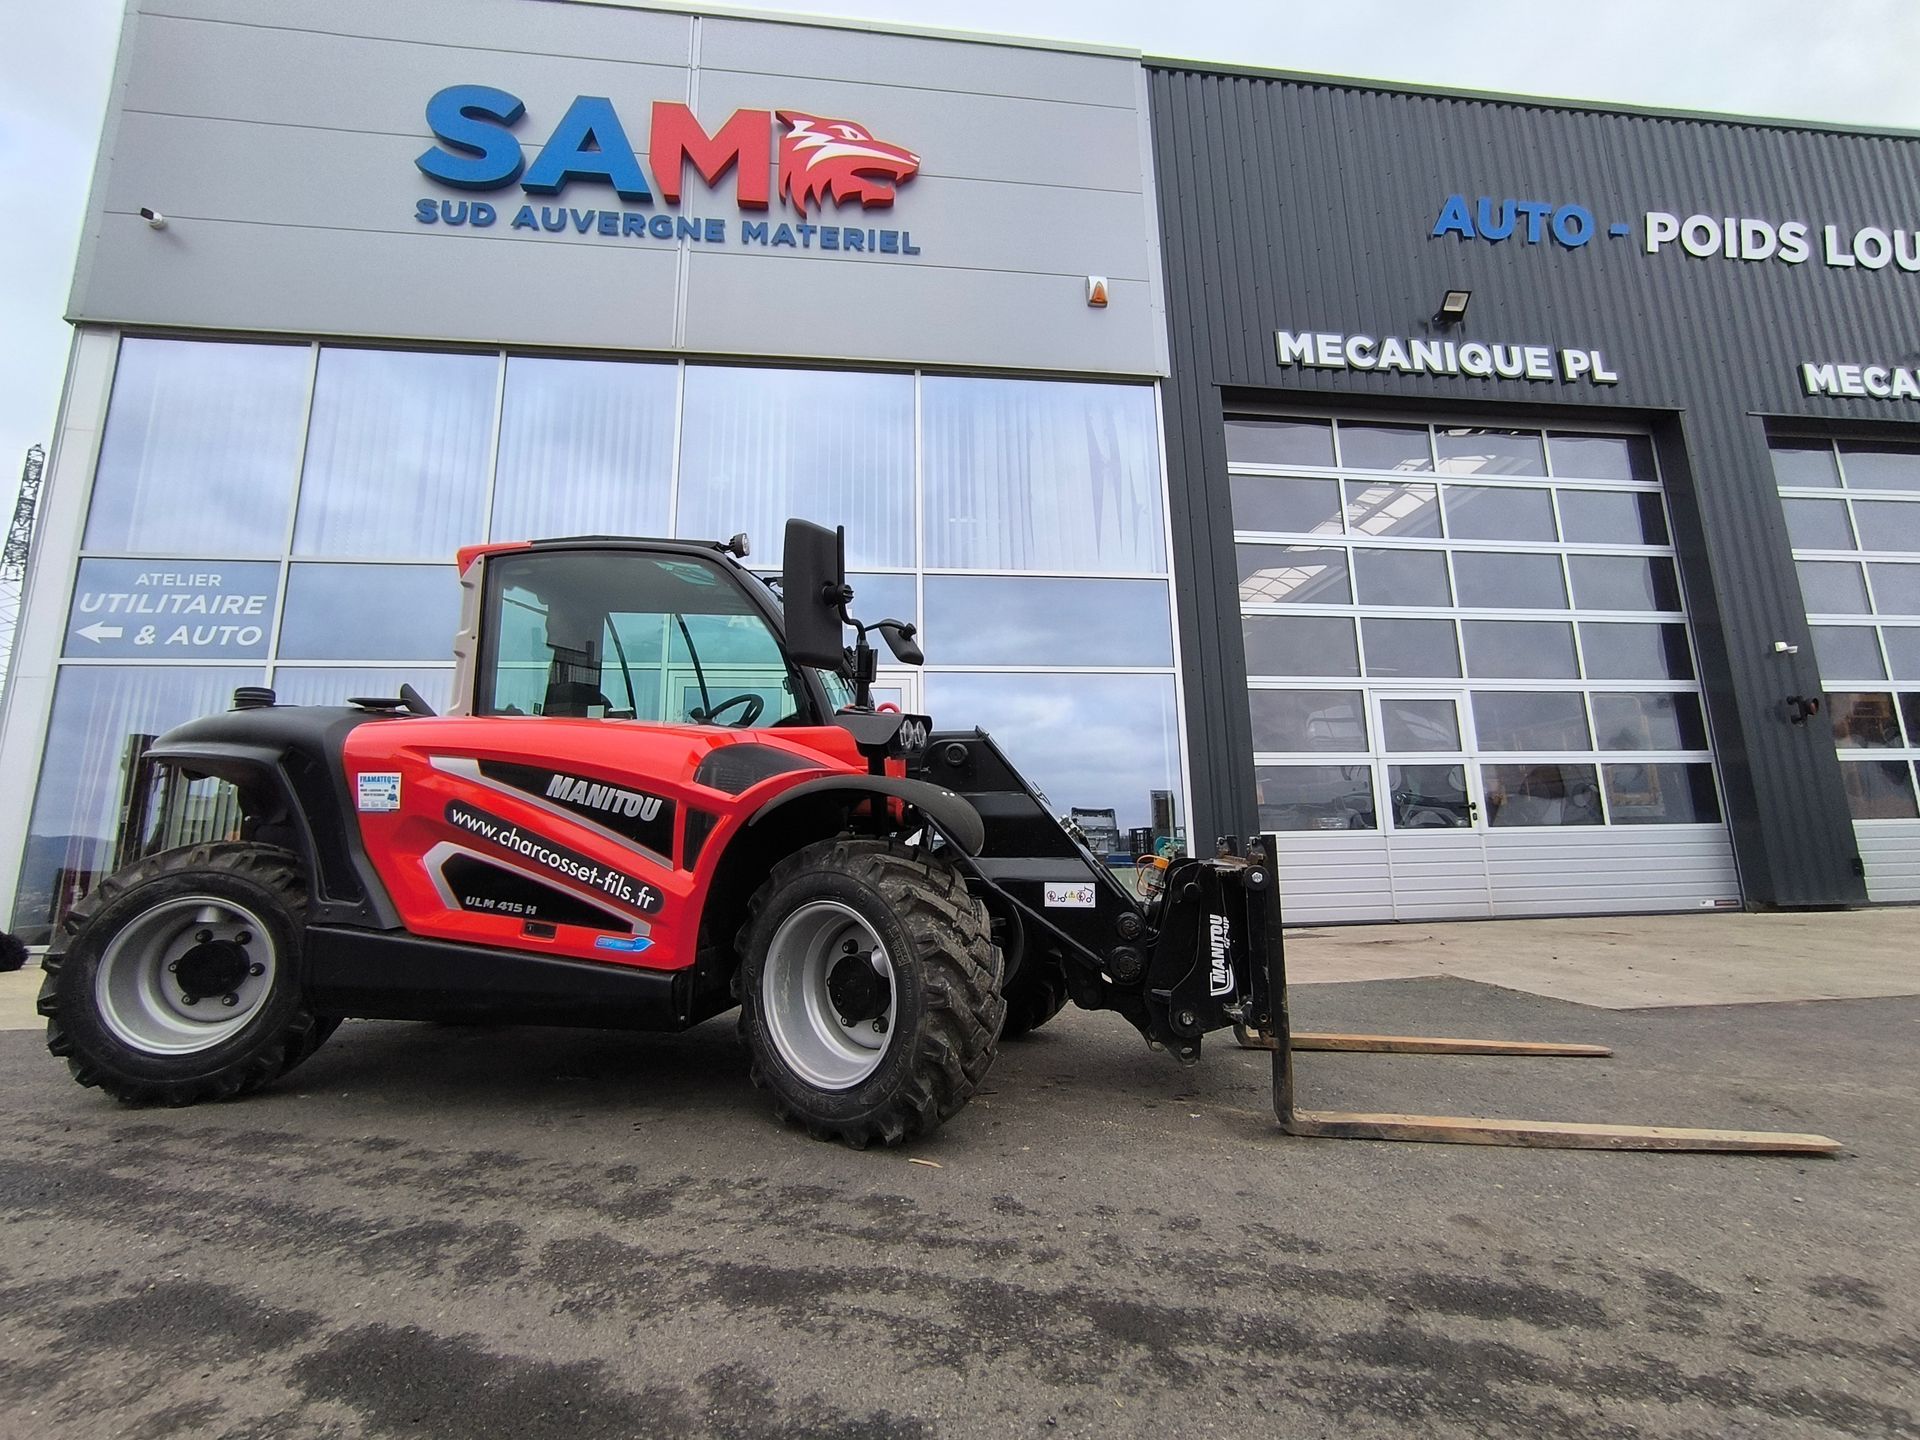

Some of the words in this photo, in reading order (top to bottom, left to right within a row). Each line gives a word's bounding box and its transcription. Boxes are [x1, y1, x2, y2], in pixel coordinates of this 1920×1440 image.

[414, 84, 771, 210] SAM
[415, 199, 497, 227] SUD
[511, 205, 726, 244] AUVERGNE
[741, 220, 921, 255] MATERIEL
[1432, 195, 1595, 247] AUTO
[1645, 211, 1810, 264] POIDS
[1275, 329, 1554, 381] MECANIQUE
[1561, 347, 1618, 384] PL
[1801, 361, 1920, 400] MECA
[79, 592, 267, 615] UTILITAIRE
[135, 573, 222, 587] ATELIER
[133, 625, 156, 646] &
[165, 625, 263, 646] AUTO
[545, 774, 662, 822] MANITOU
[452, 808, 654, 910] www.charcosset-fils.fr
[465, 896, 495, 909] ULM
[497, 901, 523, 913] 415
[525, 904, 537, 915] H
[1210, 913, 1226, 984] MANITOU
